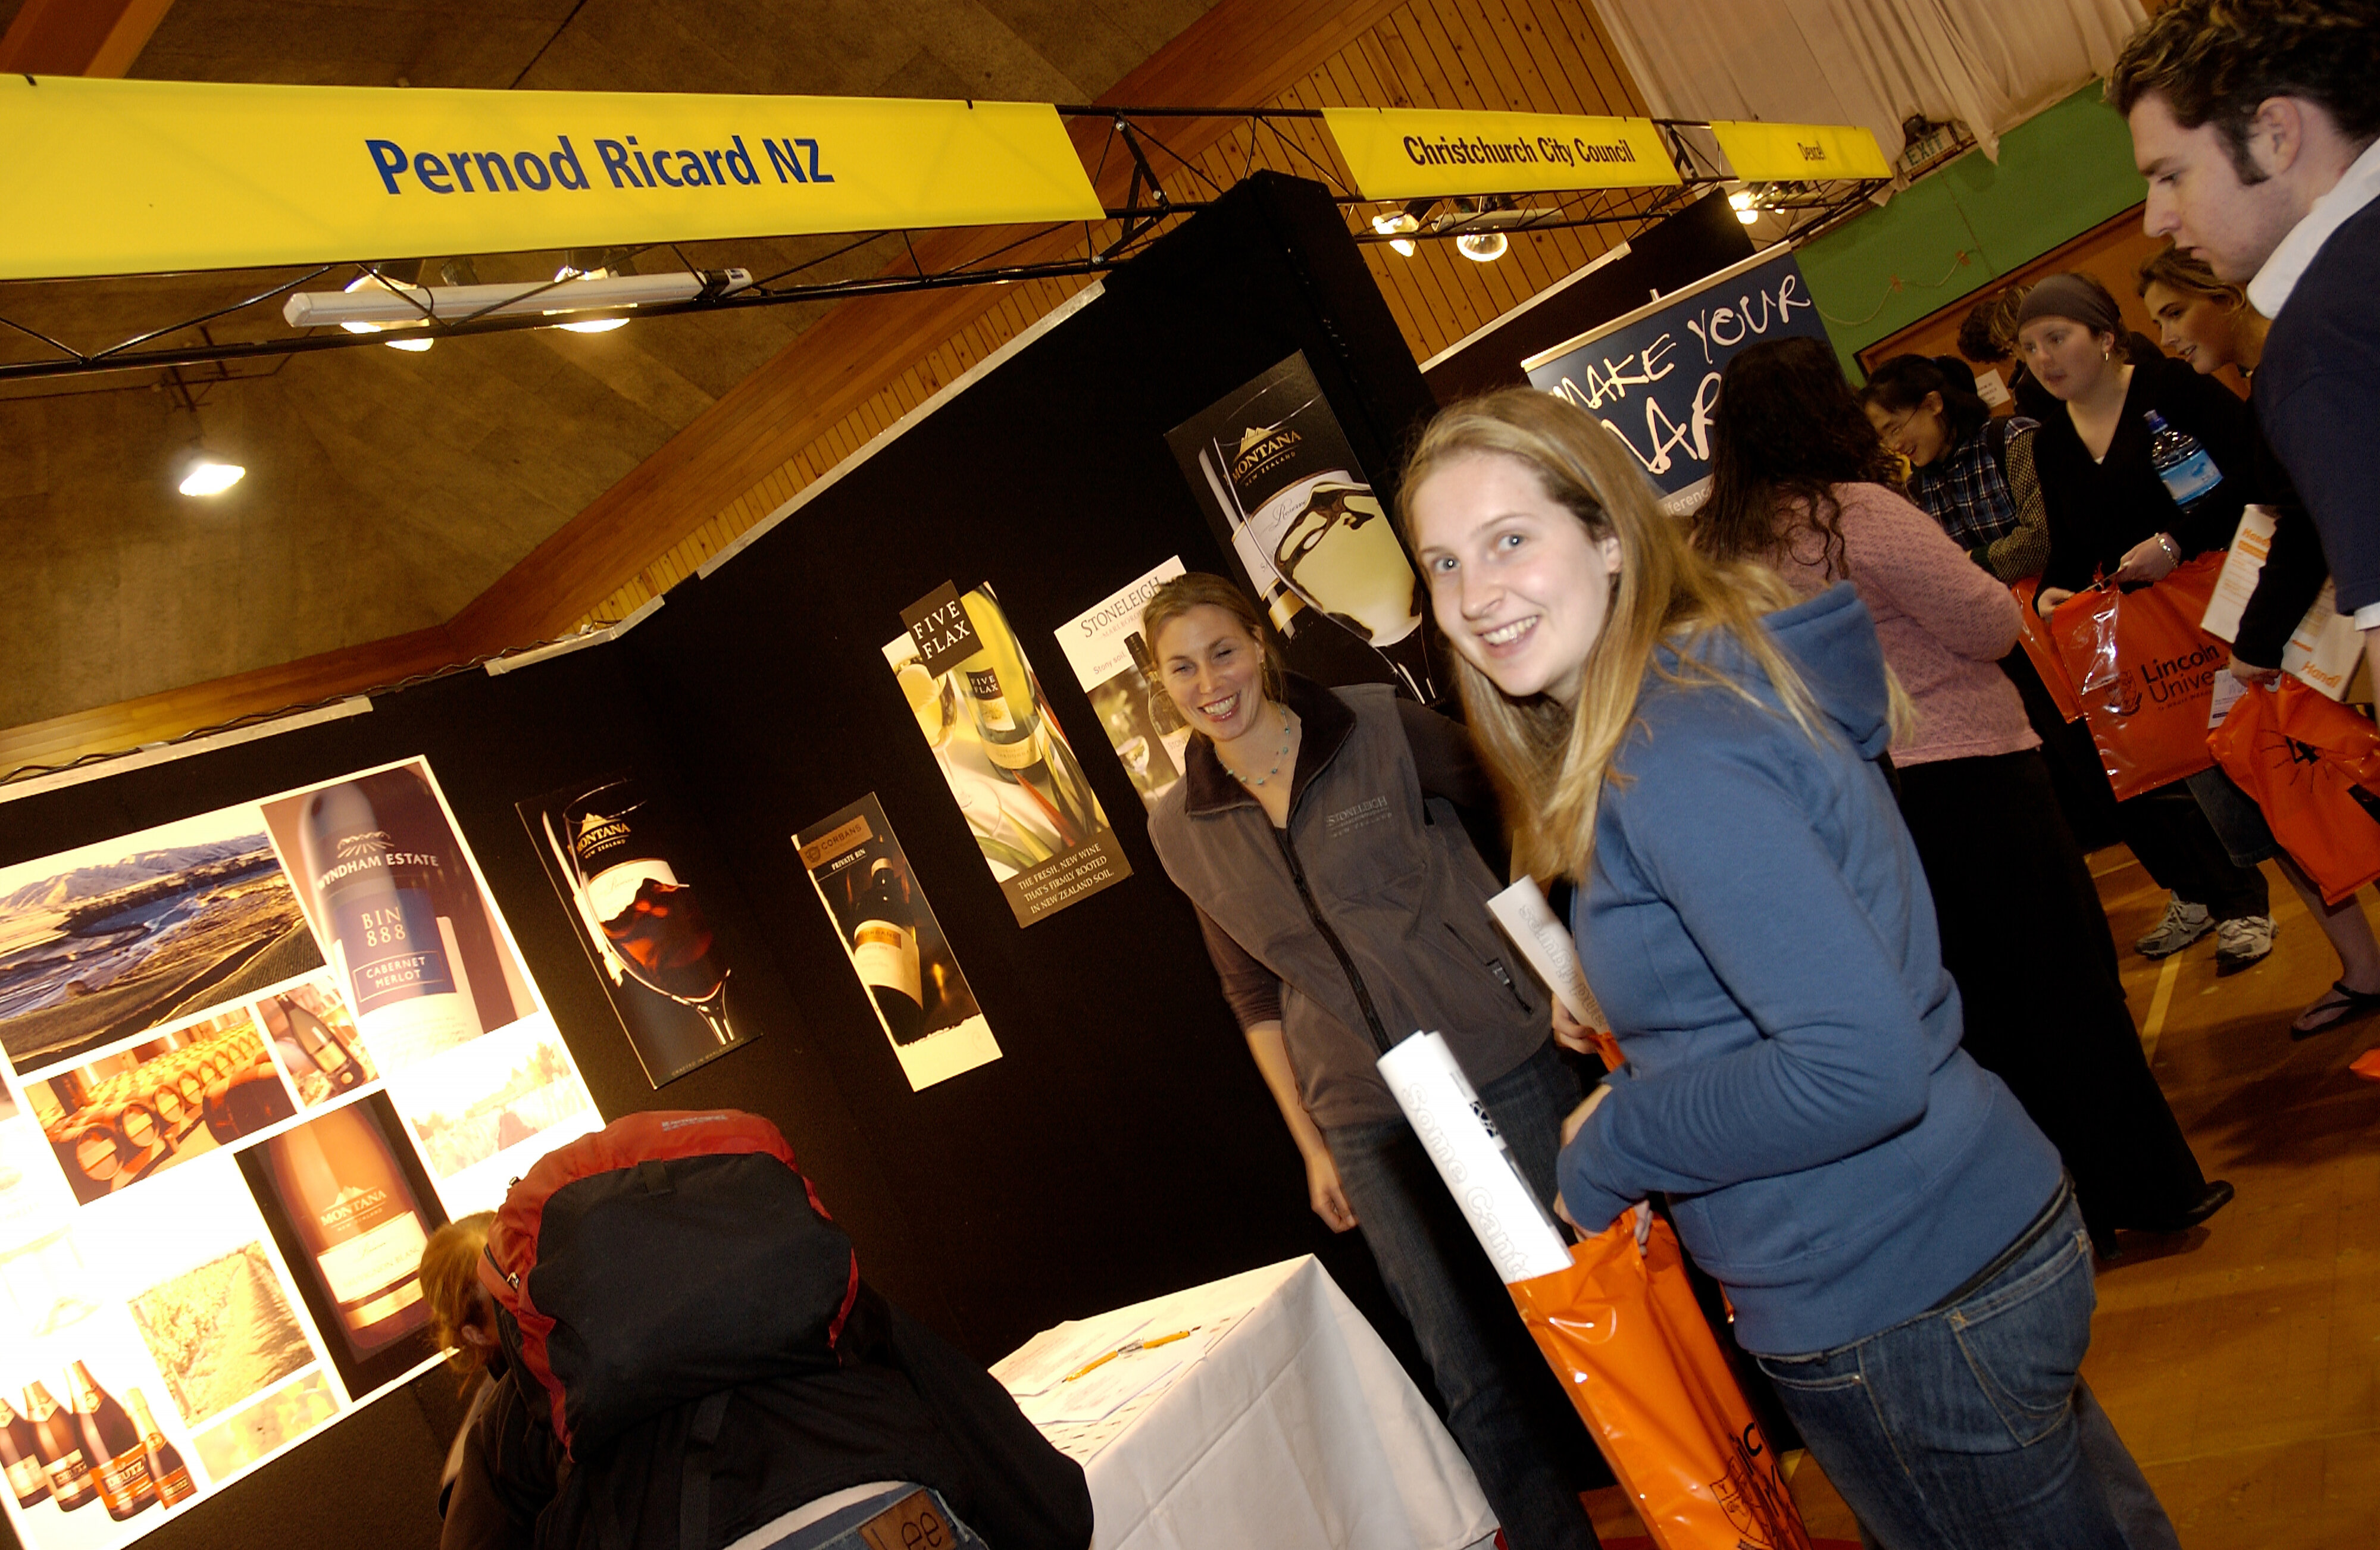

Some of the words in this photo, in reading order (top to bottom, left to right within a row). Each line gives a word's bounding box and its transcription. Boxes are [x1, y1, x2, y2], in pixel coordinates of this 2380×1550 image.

[365, 135, 592, 195] Pernod
[594, 135, 761, 189] Ricard
[762, 137, 835, 183] NZ
[1403, 136, 1539, 166] Christchurch
[1537, 137, 1575, 167] City
[1574, 137, 1637, 163] Council
[1797, 140, 1827, 161] Dexcel
[1552, 333, 1677, 409] MAKE
[1687, 274, 1811, 364] YOUR
[1261, 451, 1296, 474] ZEALAND
[912, 600, 960, 640] FIVE
[1080, 576, 1162, 638] STONELEIGH
[922, 619, 971, 660] FLAX
[2141, 643, 2220, 684] Lincoln
[974, 682, 999, 694] FLAX
[821, 823, 862, 850] CORBANS
[385, 853, 439, 867] ESTATE
[831, 853, 855, 870] PRIVATE
[1017, 876, 1034, 891] THE
[1059, 853, 1078, 870] NEW
[1078, 843, 1102, 860] WINE
[1023, 884, 1049, 903] THAT'S
[1048, 870, 1075, 891] FIRMLY
[1075, 855, 1108, 877] ROOTED
[1030, 903, 1041, 915] IN
[1040, 894, 1058, 909] NEW
[1058, 877, 1093, 901] ZEALAND
[361, 907, 402, 930] BIN
[366, 924, 406, 947] 888
[366, 956, 426, 979] CABERNET
[374, 970, 421, 989] MERLOT
[1402, 1083, 1468, 1184] Some
[320, 1189, 387, 1226] MONTANA
[105, 1461, 145, 1488] DEUTZ
